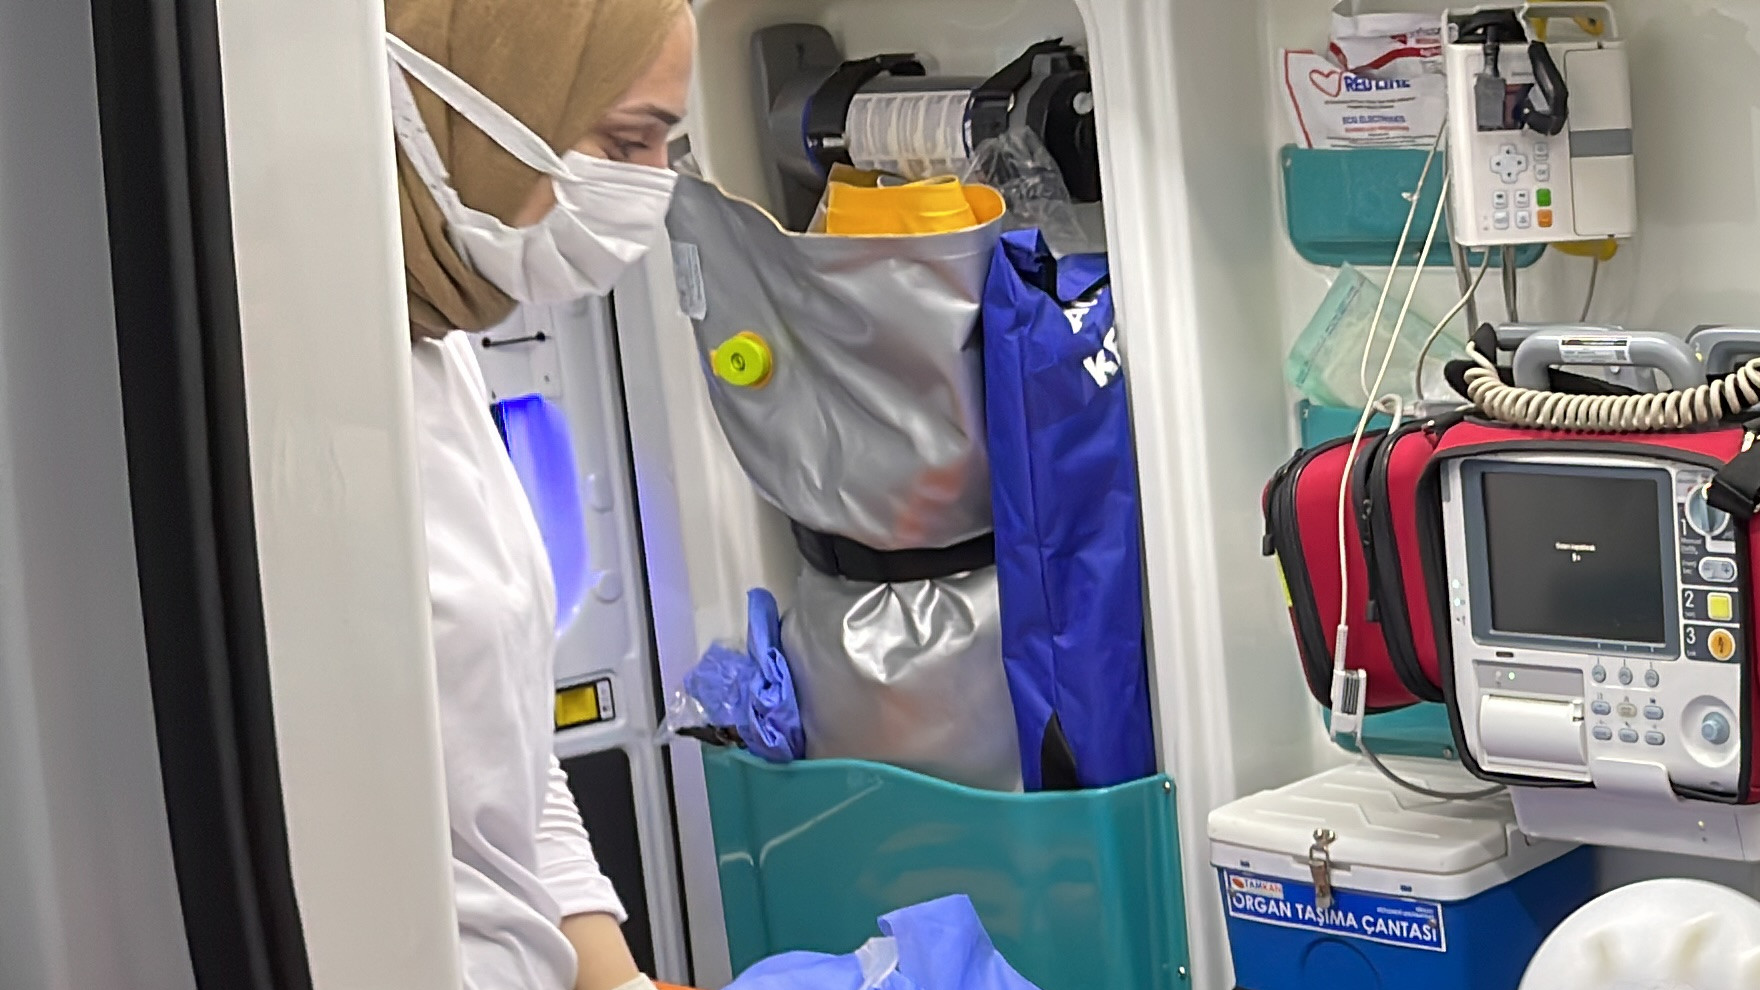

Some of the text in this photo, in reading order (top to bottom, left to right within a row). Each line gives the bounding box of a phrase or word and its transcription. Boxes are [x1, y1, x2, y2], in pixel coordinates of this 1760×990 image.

[1681, 518, 1687, 536] 1
[1684, 591, 1695, 608] 2
[1686, 627, 1696, 644] 3
[1232, 892, 1293, 918] ORGAN
[1295, 903, 1358, 928] TAŞIMA
